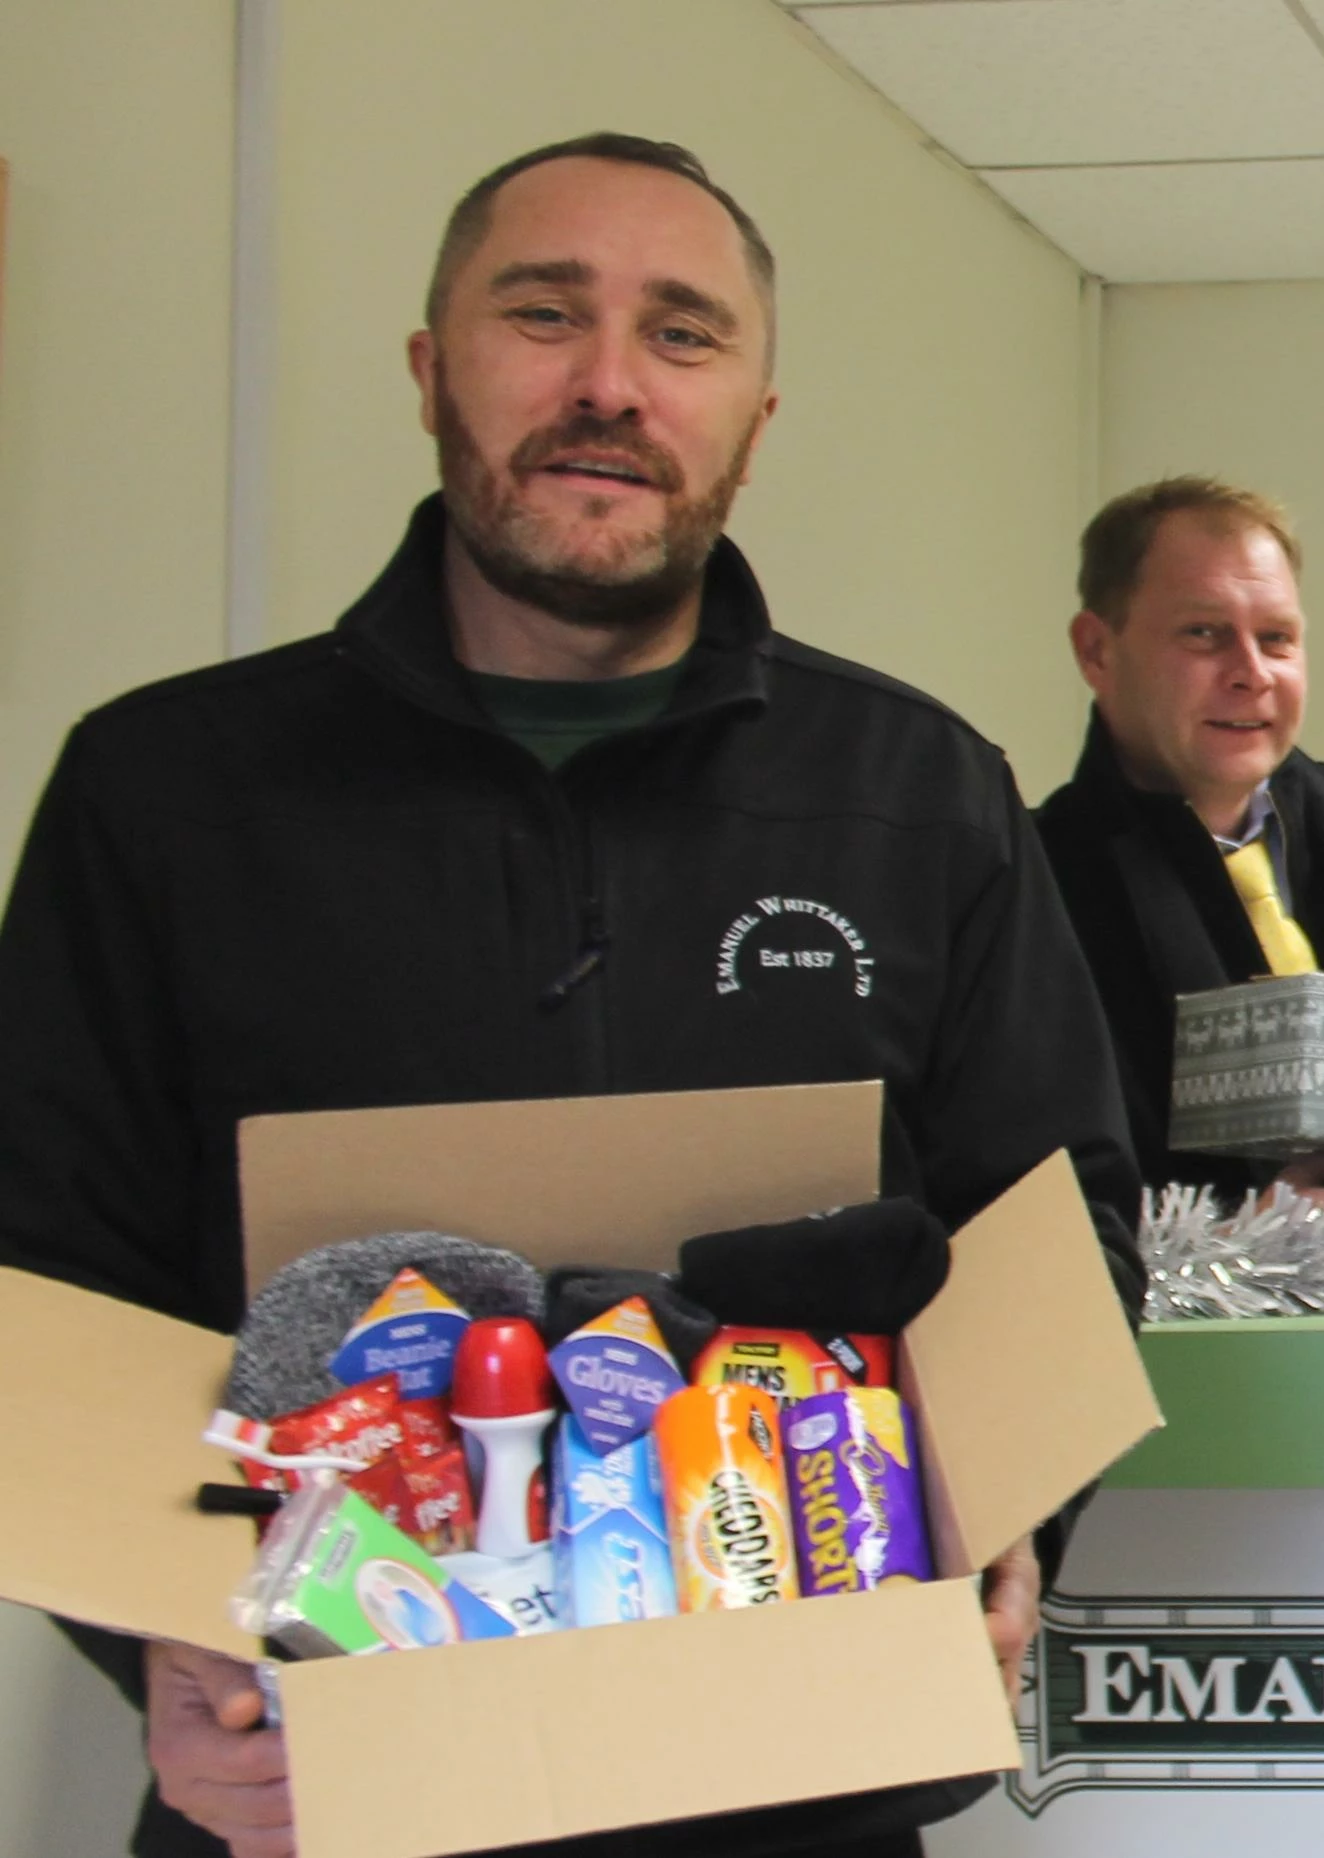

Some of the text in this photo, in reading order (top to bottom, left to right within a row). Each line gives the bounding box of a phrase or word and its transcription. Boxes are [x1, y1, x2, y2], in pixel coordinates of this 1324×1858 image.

[716, 914, 761, 995] EMANUEL
[756, 896, 865, 952] WHITTAKER
[760, 949, 835, 968] Est 1837
[364, 1337, 451, 1373] Beanie
[566, 1354, 667, 1405] Gloves
[797, 1449, 859, 1593] SHORT
